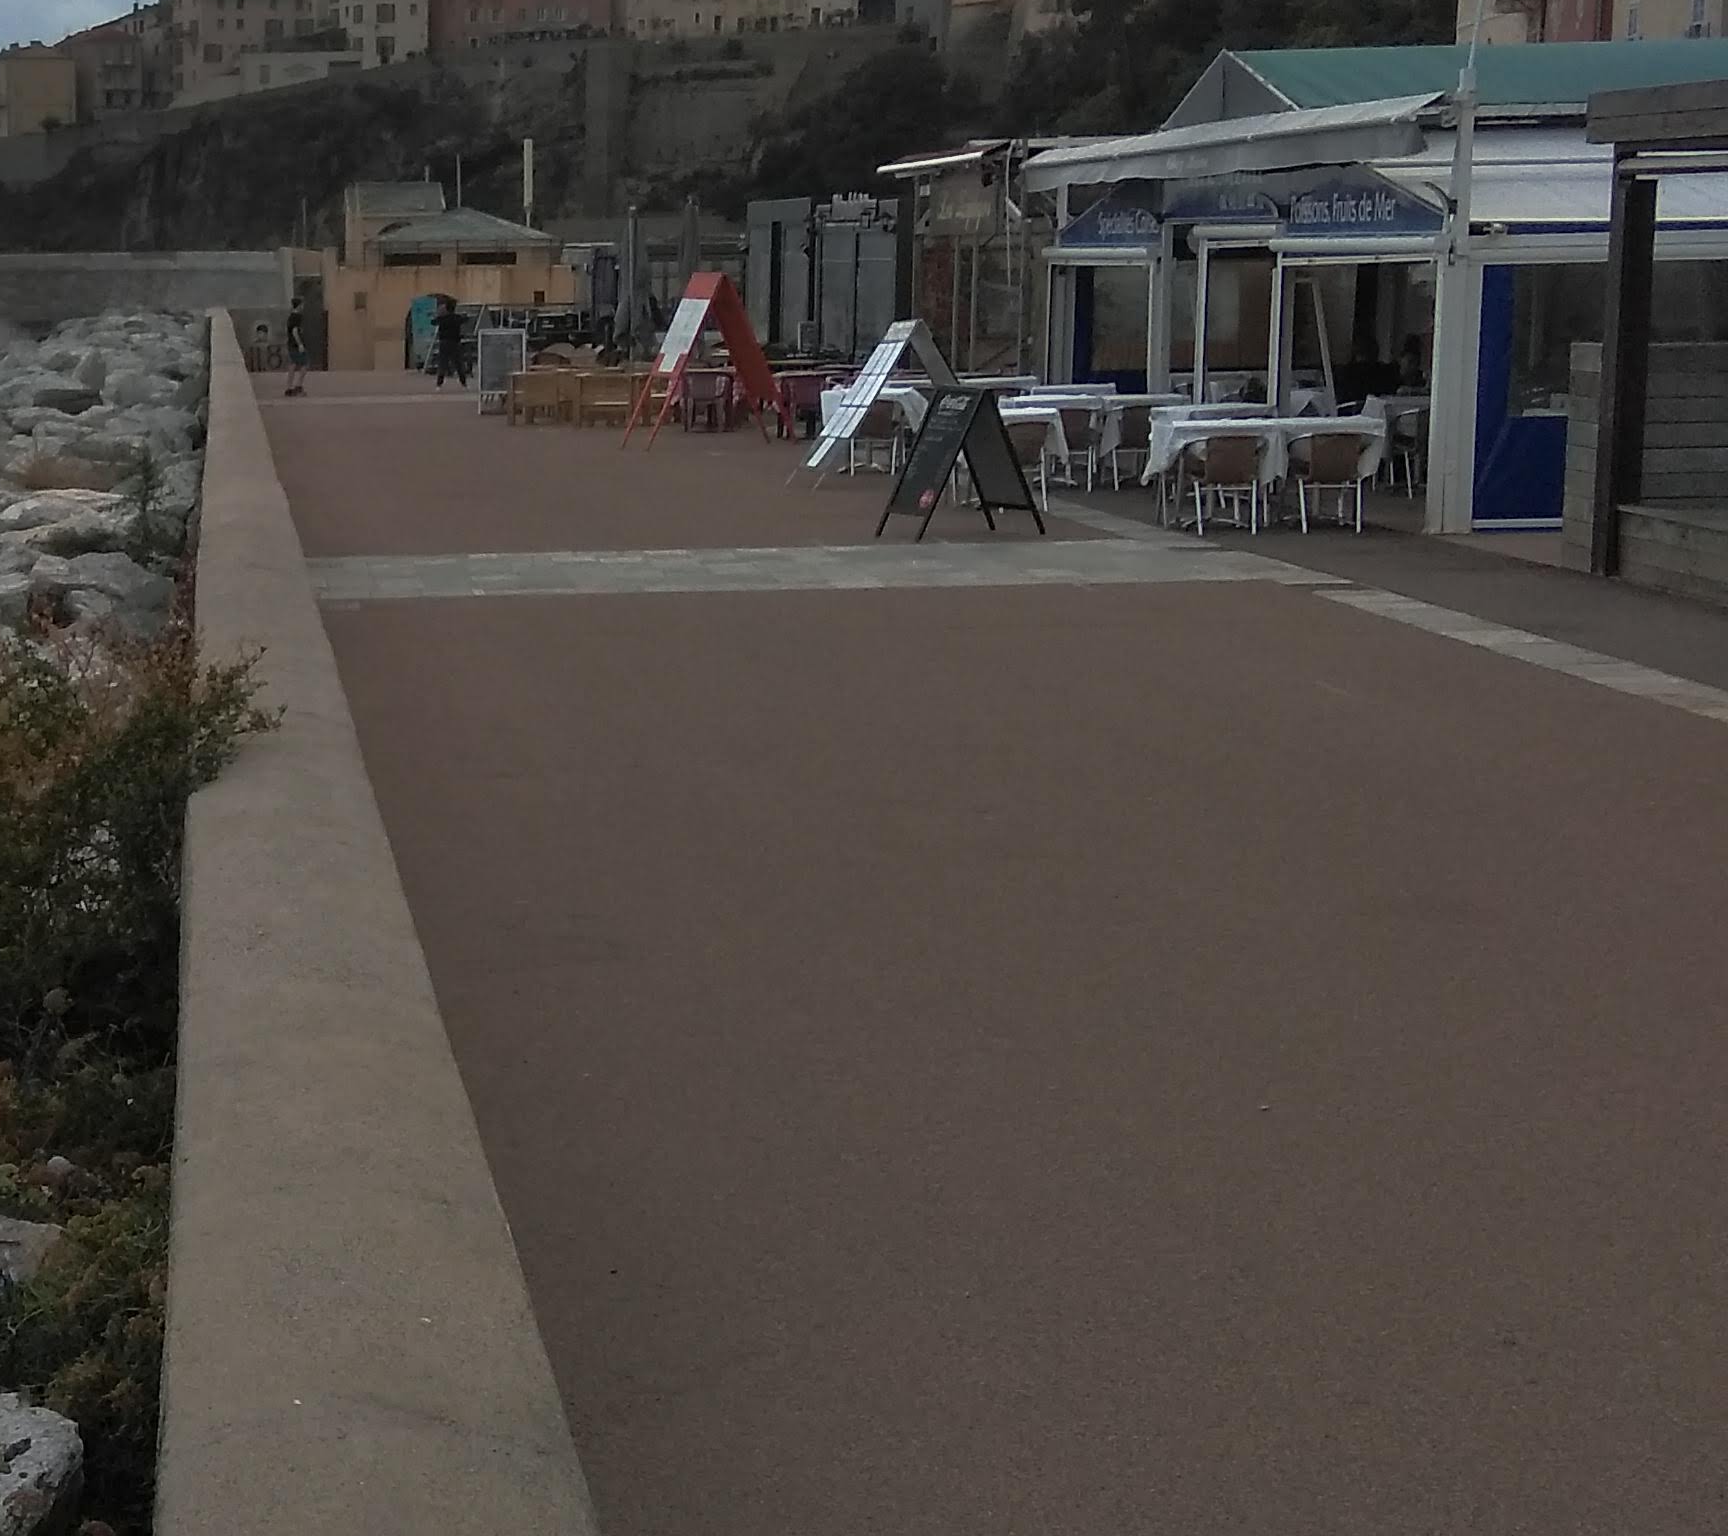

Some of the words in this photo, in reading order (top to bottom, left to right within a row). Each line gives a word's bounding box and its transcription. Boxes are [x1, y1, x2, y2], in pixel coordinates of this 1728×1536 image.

[1333, 192, 1356, 222] Fruits
[1358, 191, 1372, 222] de
[1374, 191, 1396, 221] Mer
